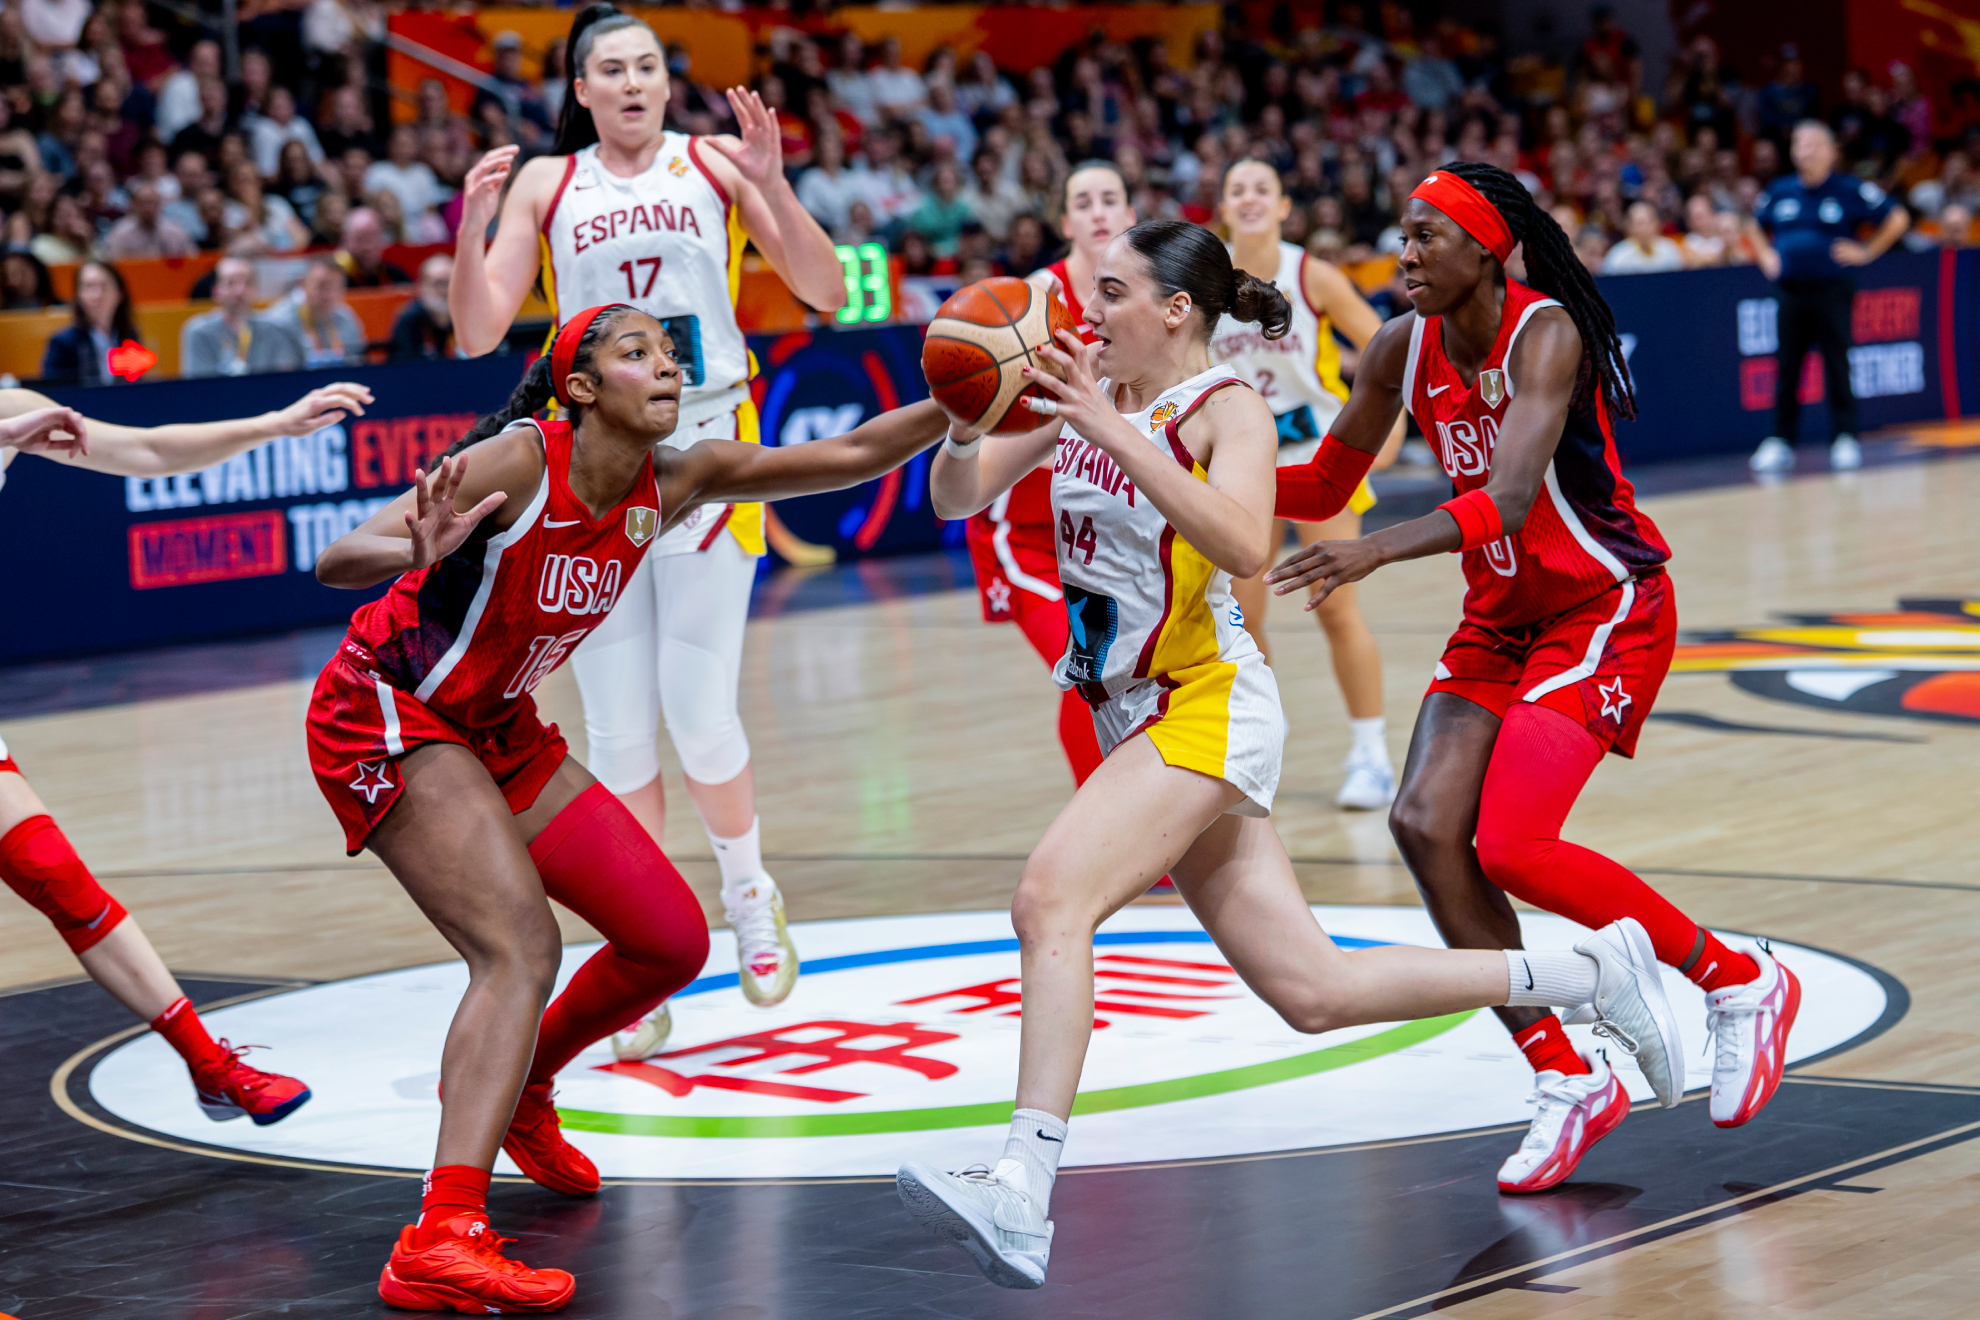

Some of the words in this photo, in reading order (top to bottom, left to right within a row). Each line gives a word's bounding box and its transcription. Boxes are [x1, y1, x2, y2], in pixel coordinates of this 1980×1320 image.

[573, 199, 702, 255] ESPAÑA
[618, 256, 662, 300] 17
[1256, 368, 1278, 398] 2
[1060, 508, 1097, 566] 44
[537, 554, 622, 615] USA
[503, 628, 588, 699] 15
